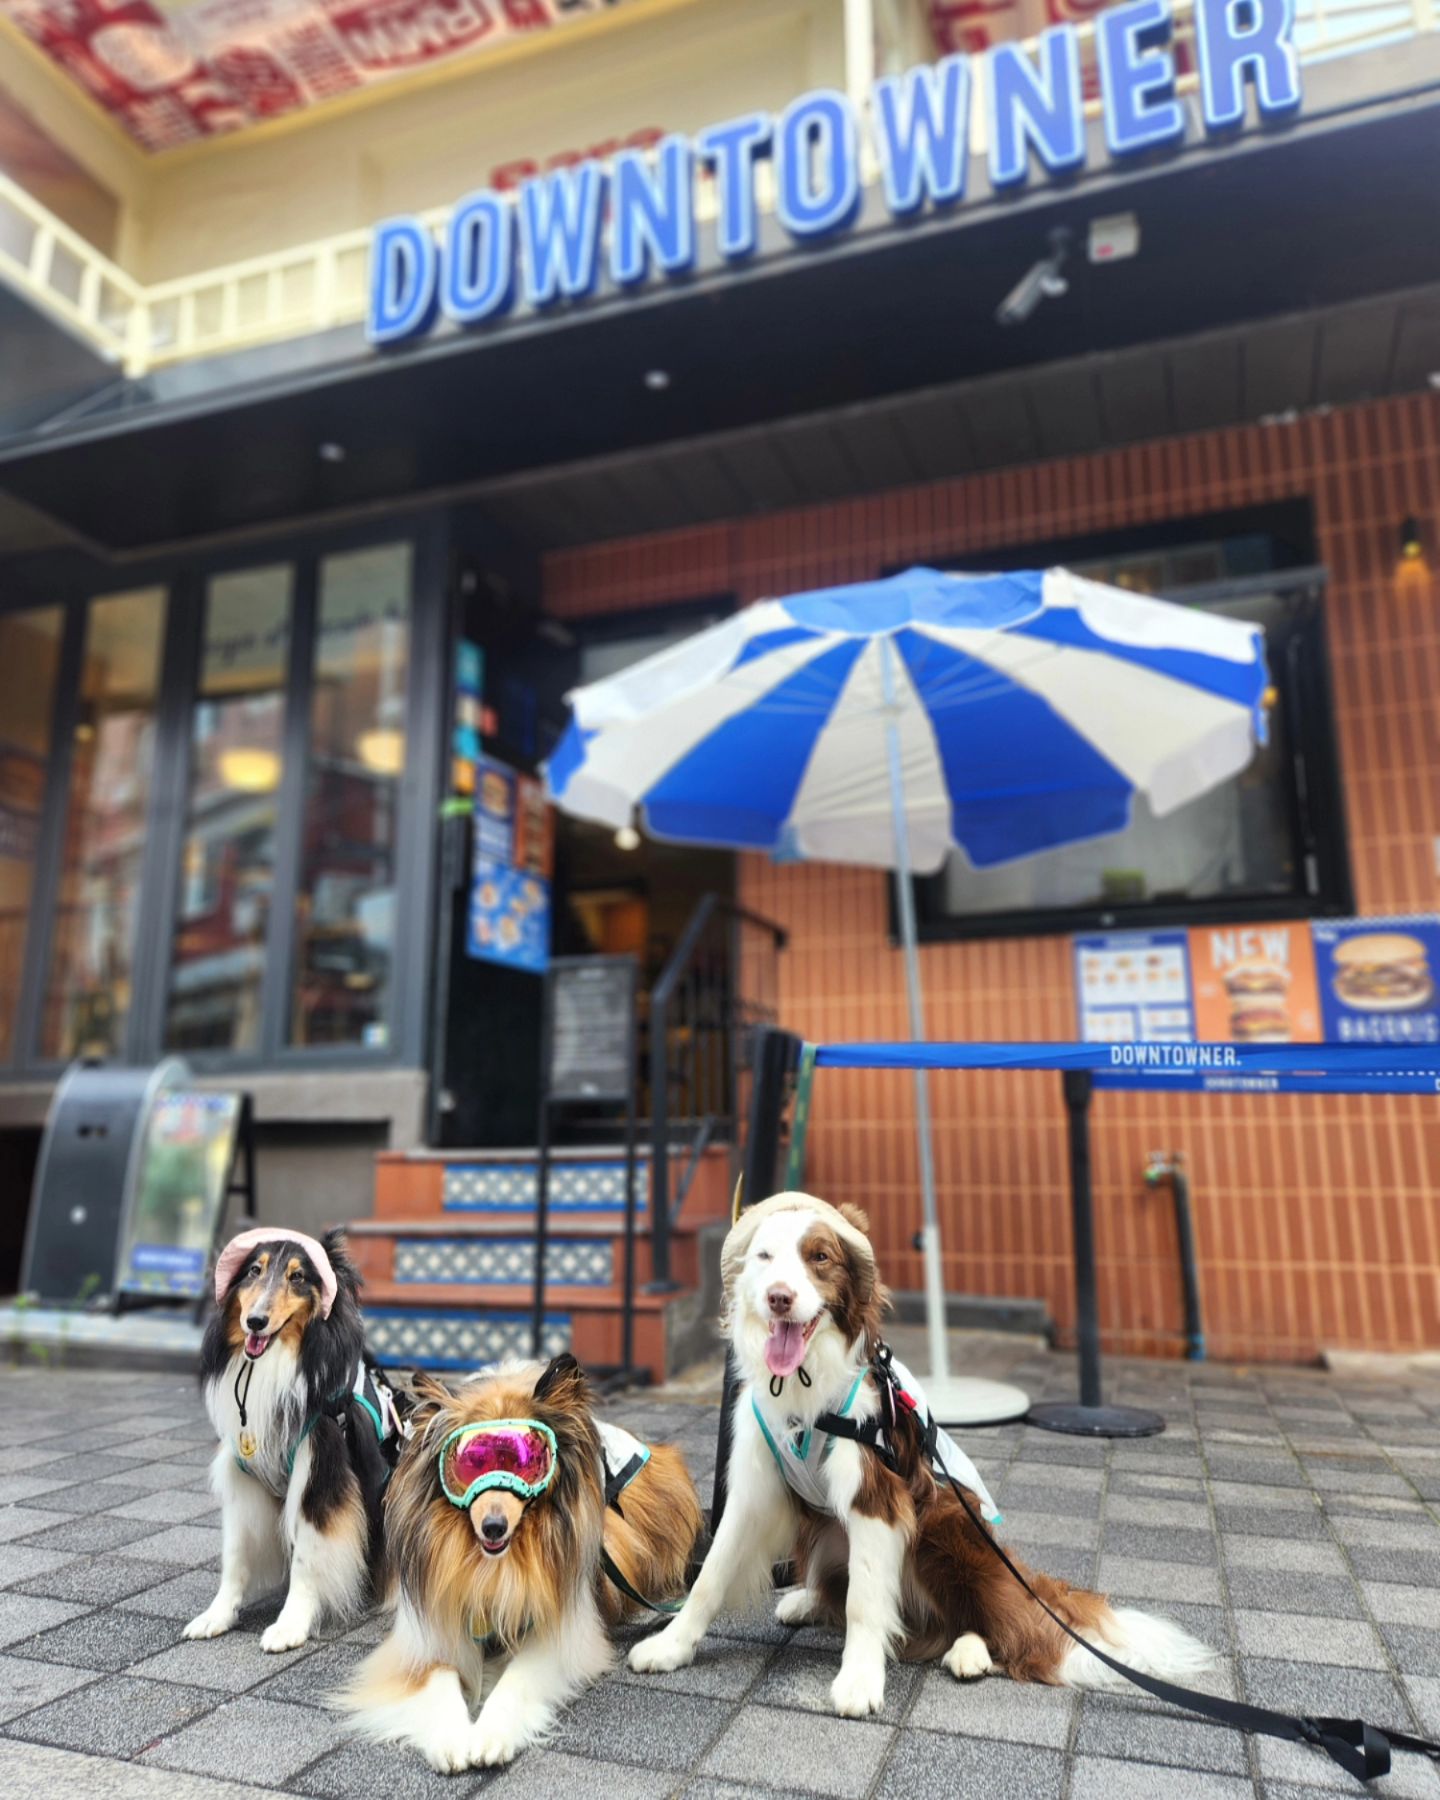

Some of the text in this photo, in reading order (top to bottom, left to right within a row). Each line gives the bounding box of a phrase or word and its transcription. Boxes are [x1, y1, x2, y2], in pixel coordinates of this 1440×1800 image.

[366, 0, 1302, 344] DOWNTOWNER
[1211, 927, 1290, 970] NEW
[1110, 1045, 1242, 1066] DOWNTOWNER.
